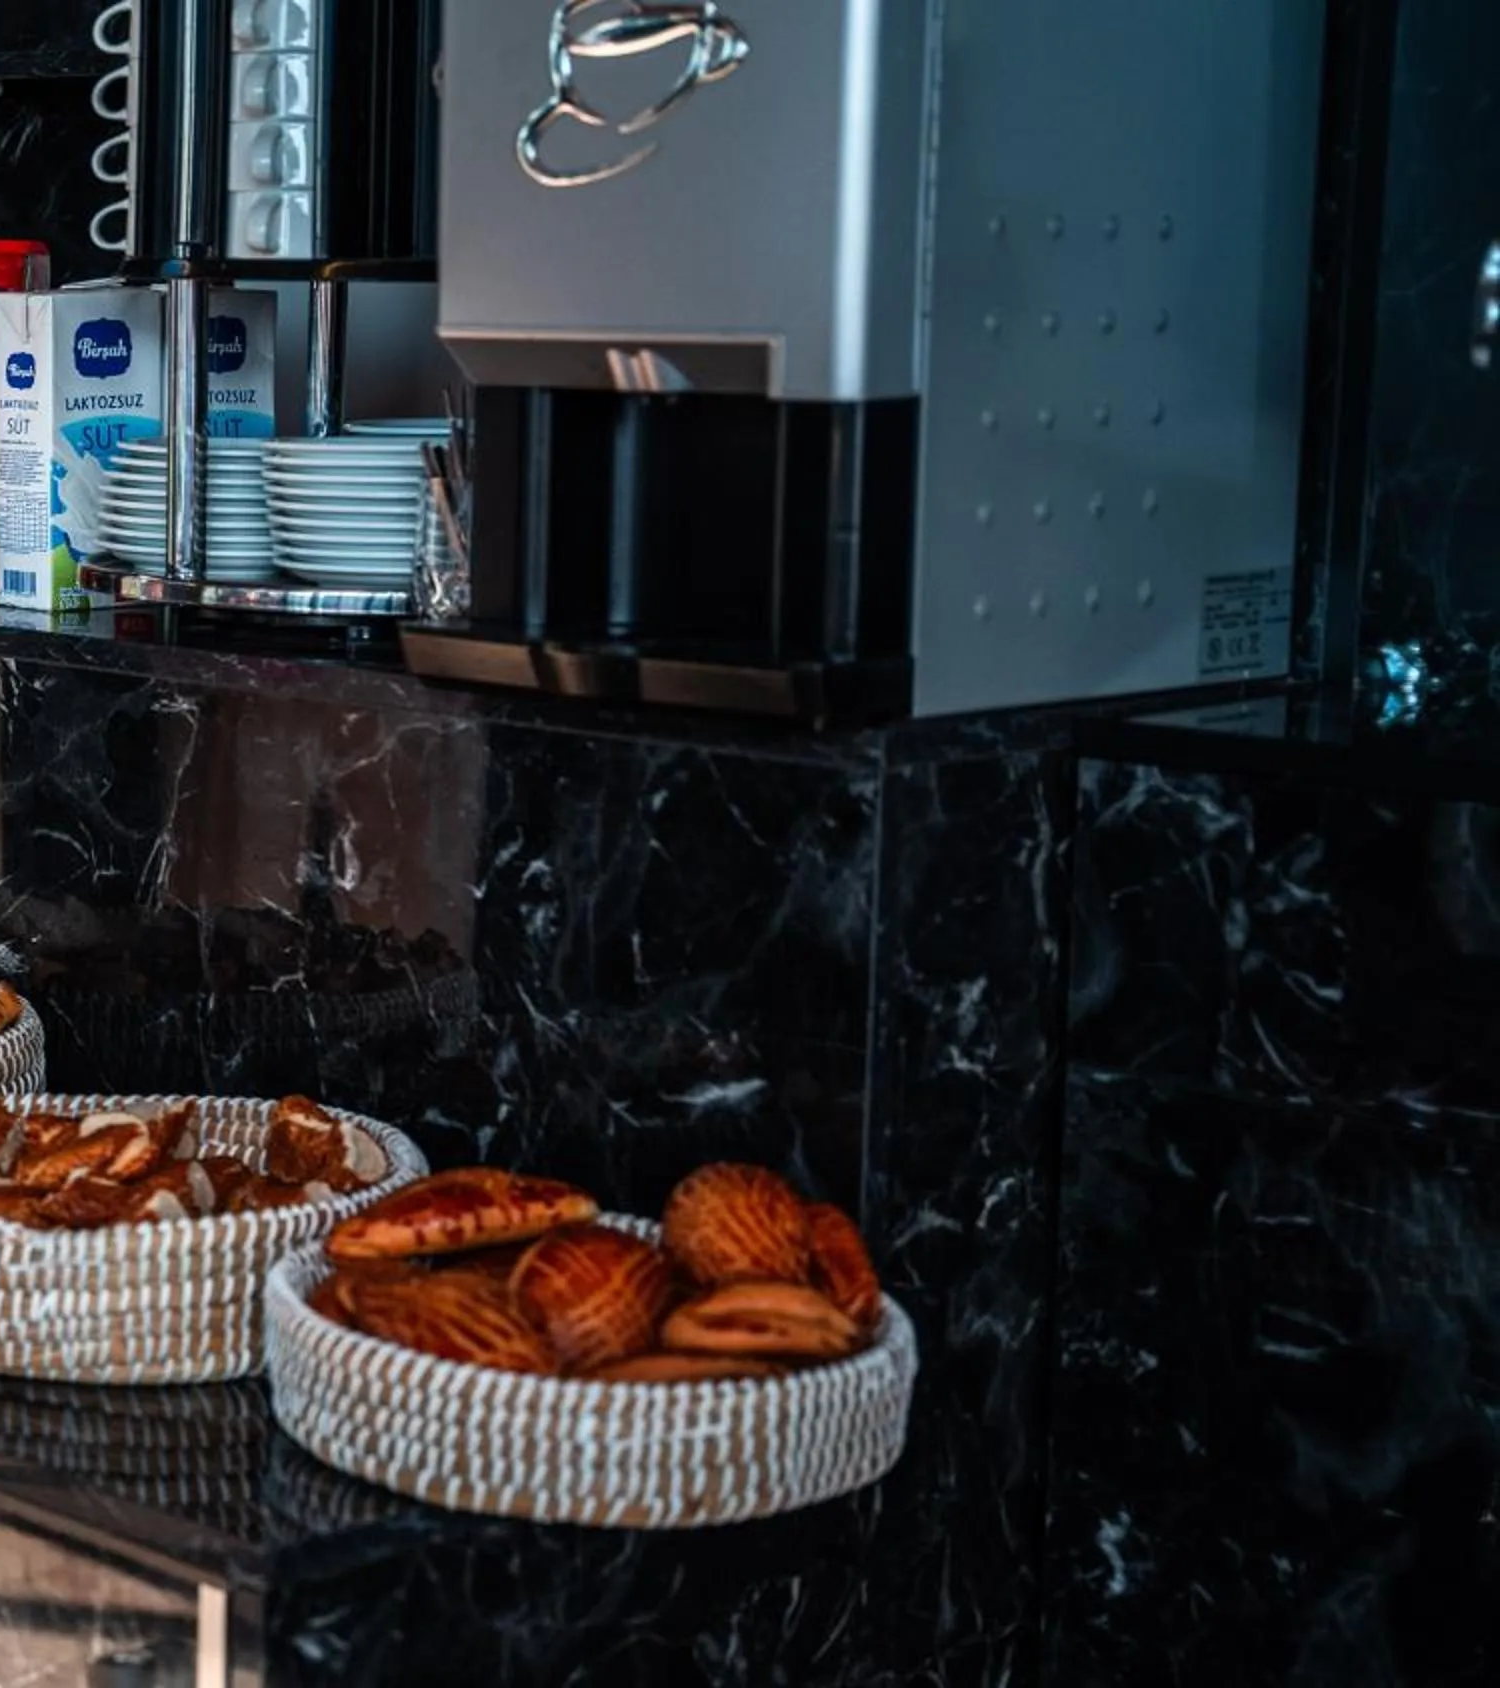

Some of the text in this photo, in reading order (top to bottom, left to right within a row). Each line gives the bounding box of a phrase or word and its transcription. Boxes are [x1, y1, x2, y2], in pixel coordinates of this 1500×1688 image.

[207, 335, 243, 356] irşah
[64, 393, 145, 412] LAKTOZSUZ
[208, 388, 257, 404] TOZSUZ
[83, 417, 129, 451] SÜT
